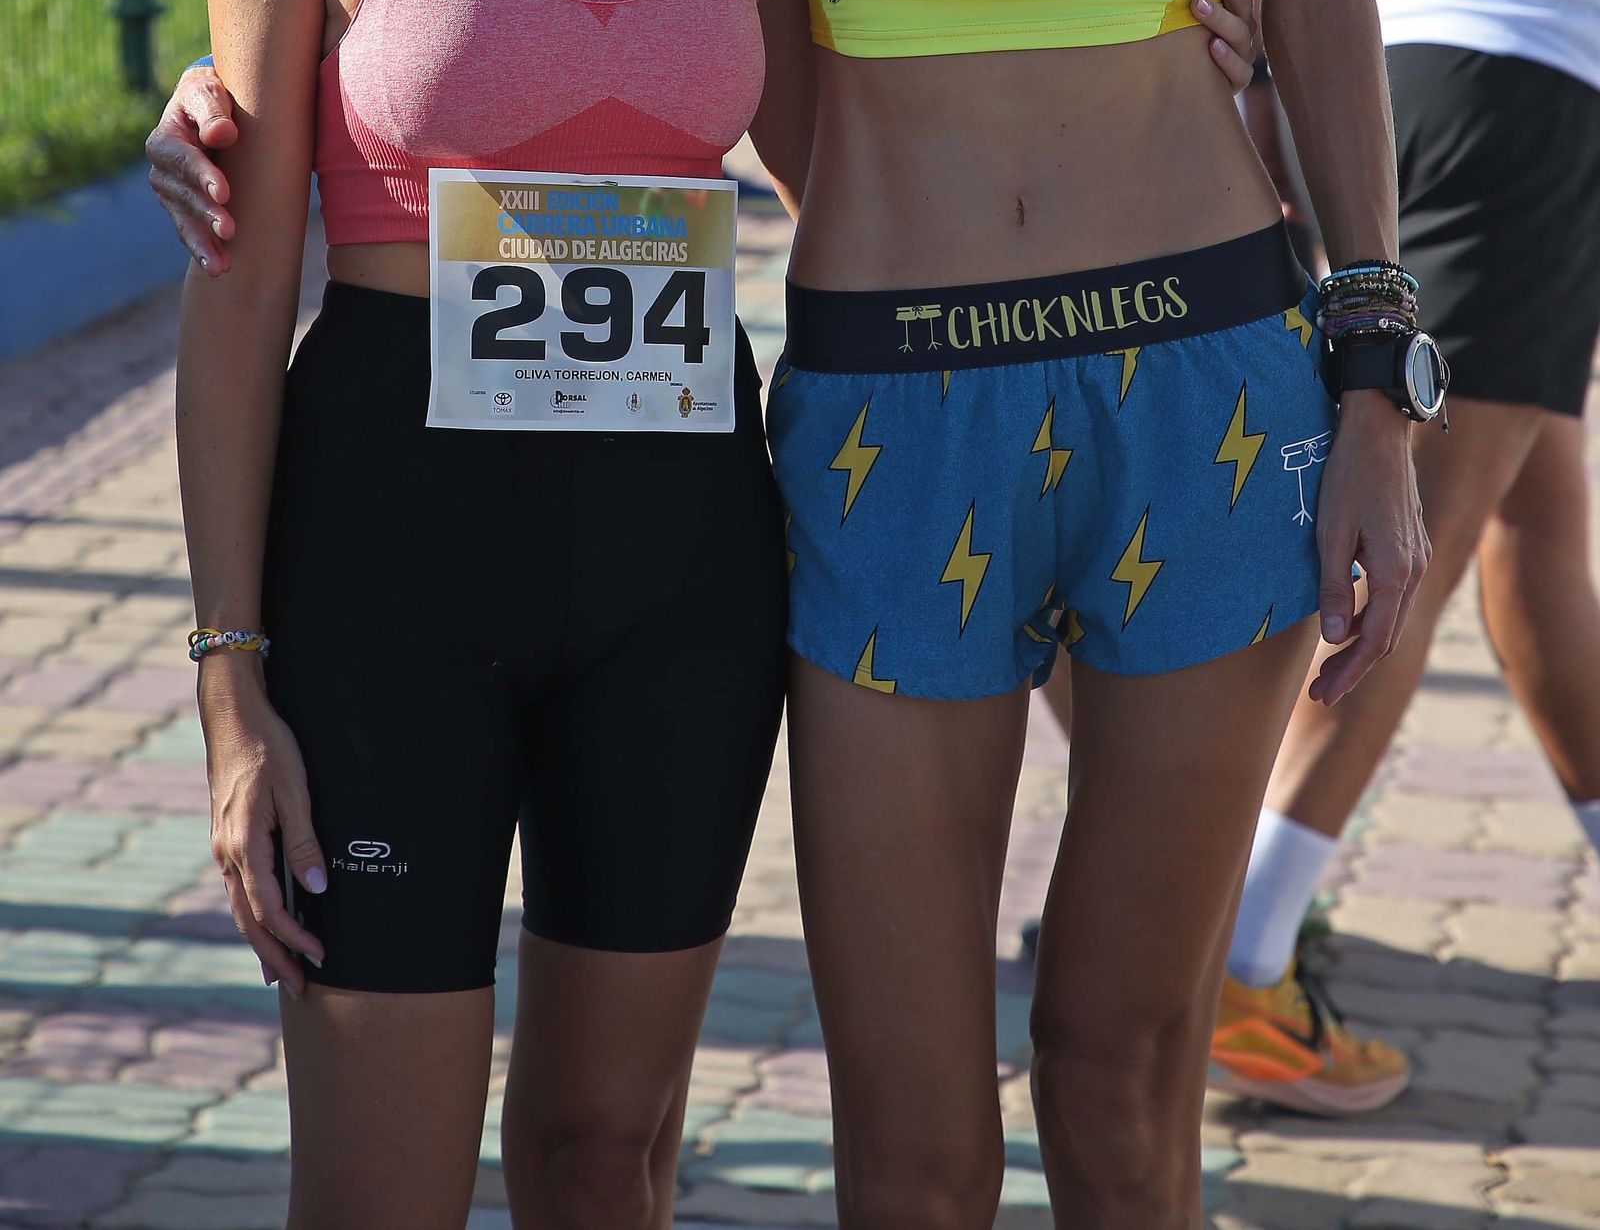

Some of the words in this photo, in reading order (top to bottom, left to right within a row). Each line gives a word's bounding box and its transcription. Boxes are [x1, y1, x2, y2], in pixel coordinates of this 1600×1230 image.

[499, 189, 540, 210] XXIII
[546, 187, 619, 211] EDICIÓN
[496, 212, 595, 238] CARRERA
[599, 214, 688, 239] URBANA
[498, 238, 569, 260] CIUDAD
[572, 239, 596, 260] DE
[598, 239, 689, 263] ALGECIRAS
[470, 264, 711, 364] 294
[947, 276, 1188, 350] CHICKNLEGS
[514, 369, 551, 380] OLIVA
[554, 370, 624, 382] TORREJON,
[626, 371, 672, 382] CARMEN
[555, 390, 587, 405] DORSAL
[332, 857, 408, 877] Kalenji
